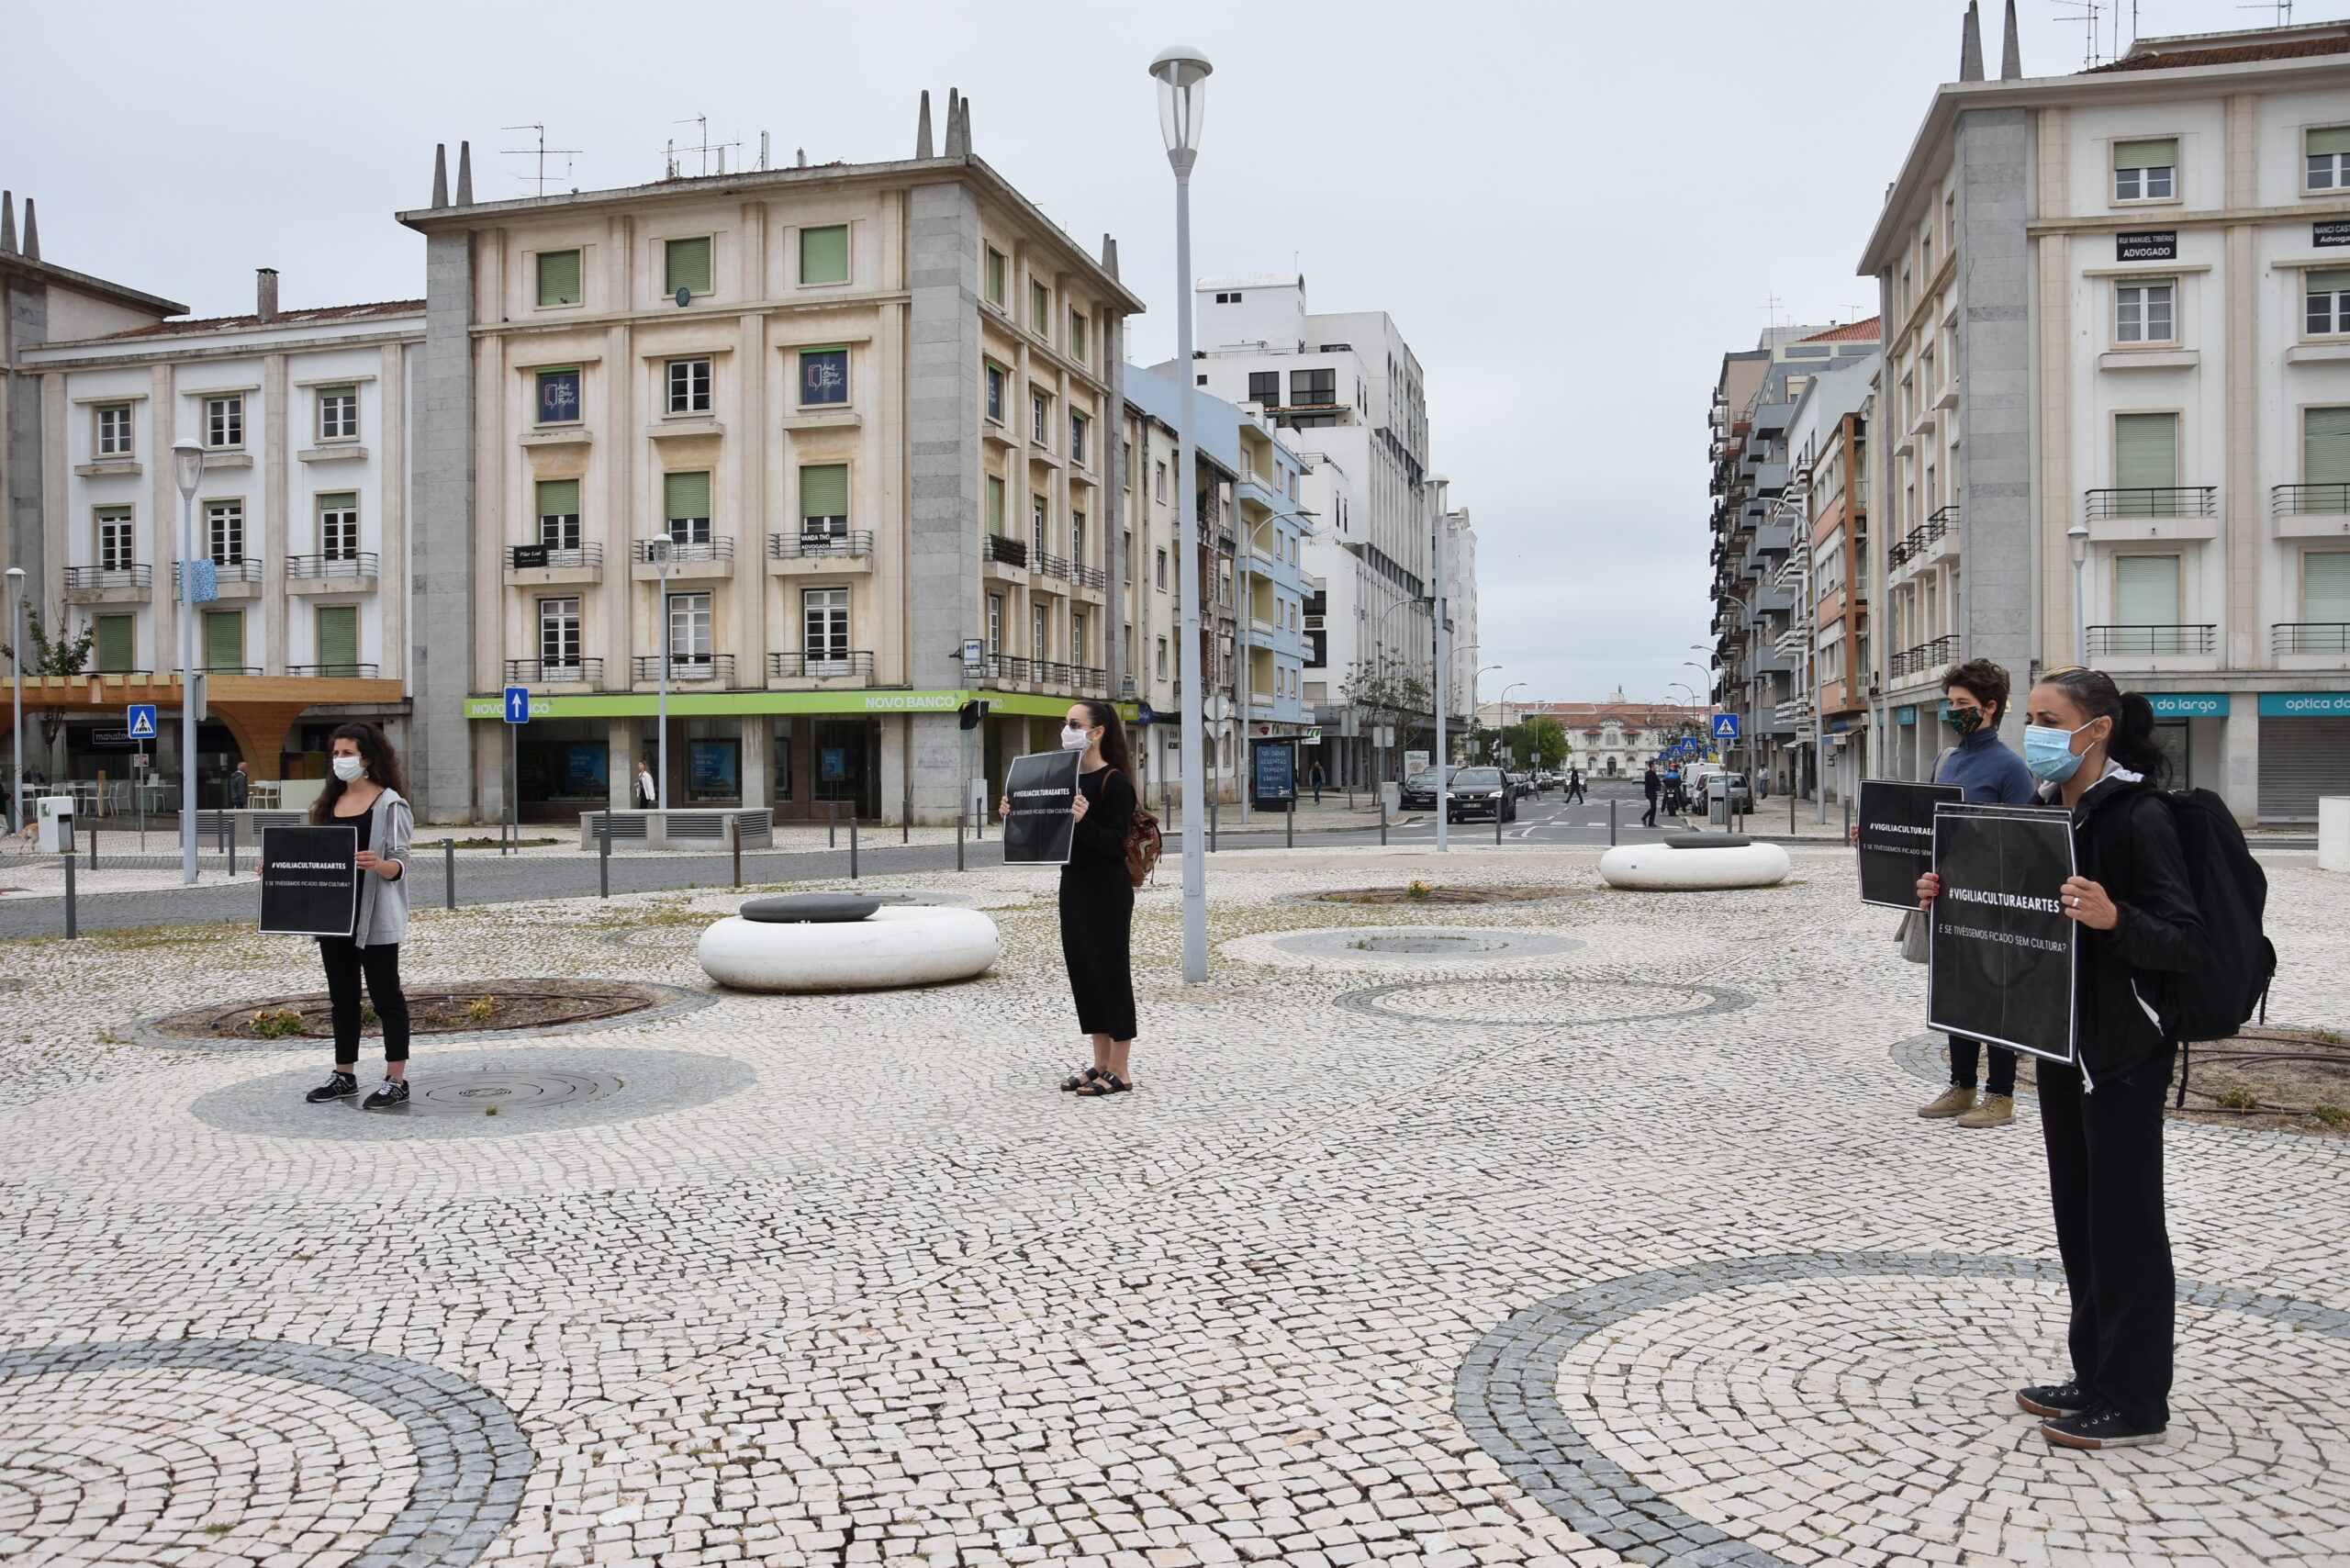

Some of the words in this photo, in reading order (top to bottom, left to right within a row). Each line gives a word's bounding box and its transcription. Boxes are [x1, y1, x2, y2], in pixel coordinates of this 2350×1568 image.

[2314, 226, 2334, 234] NANCI
[2130, 235, 2152, 243] MANUEL
[2123, 247, 2171, 257] ADVOGADO
[866, 697, 904, 709] NOVO
[907, 696, 956, 708] BANCO
[2157, 699, 2176, 711] do
[2178, 699, 2217, 713] largo
[2285, 698, 2331, 711] optica
[472, 704, 506, 714] NOVO
[1013, 788, 1069, 797] #VIGILIACULTURAEARTES
[1874, 844, 1901, 853] TIVÉSSEMOS
[1902, 847, 1920, 856] FICADO
[272, 862, 346, 870] #VIGILIACULTURAEARTES
[1949, 888, 2060, 913] #VIGILIACULTURAEARTES
[1939, 924, 1943, 934] E
[1944, 924, 1953, 935] SE
[1953, 924, 1988, 940] TIVÉSSEMOS
[1988, 931, 2014, 944] FICADO
[2015, 935, 2030, 947] SEM
[2031, 938, 2067, 953] CULTURA?
